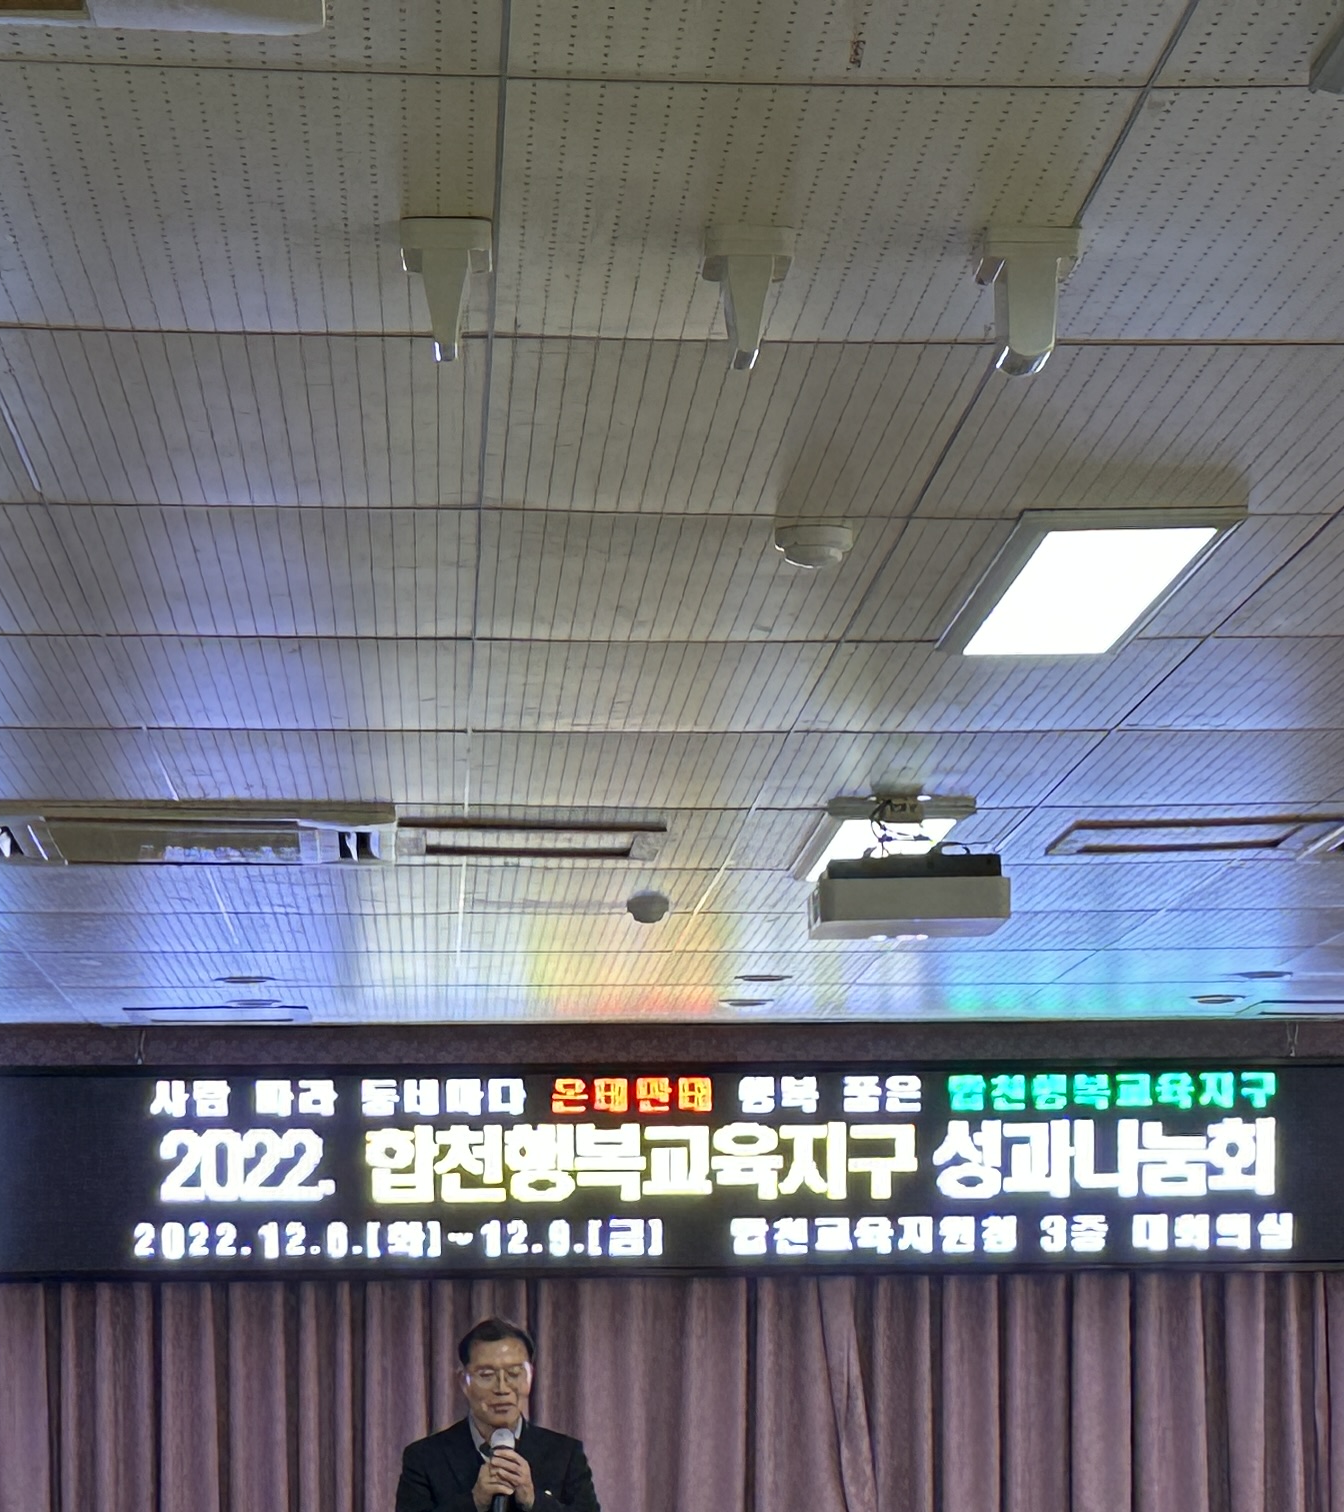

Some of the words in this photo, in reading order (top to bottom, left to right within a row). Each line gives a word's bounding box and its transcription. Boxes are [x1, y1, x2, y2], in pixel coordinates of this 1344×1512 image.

[738, 1075, 819, 1113] 행복
[842, 1074, 922, 1112] 품은
[947, 1071, 1277, 1112] 합천행복교육지구
[159, 1127, 336, 1203] 2022.
[365, 1121, 918, 1204] 합천행복교육지구
[932, 1117, 1276, 1200] 성과나눔회
[729, 1214, 1019, 1256] 합천교육지원청
[1039, 1213, 1110, 1253] 3층
[1131, 1211, 1295, 1251] 대회의실
